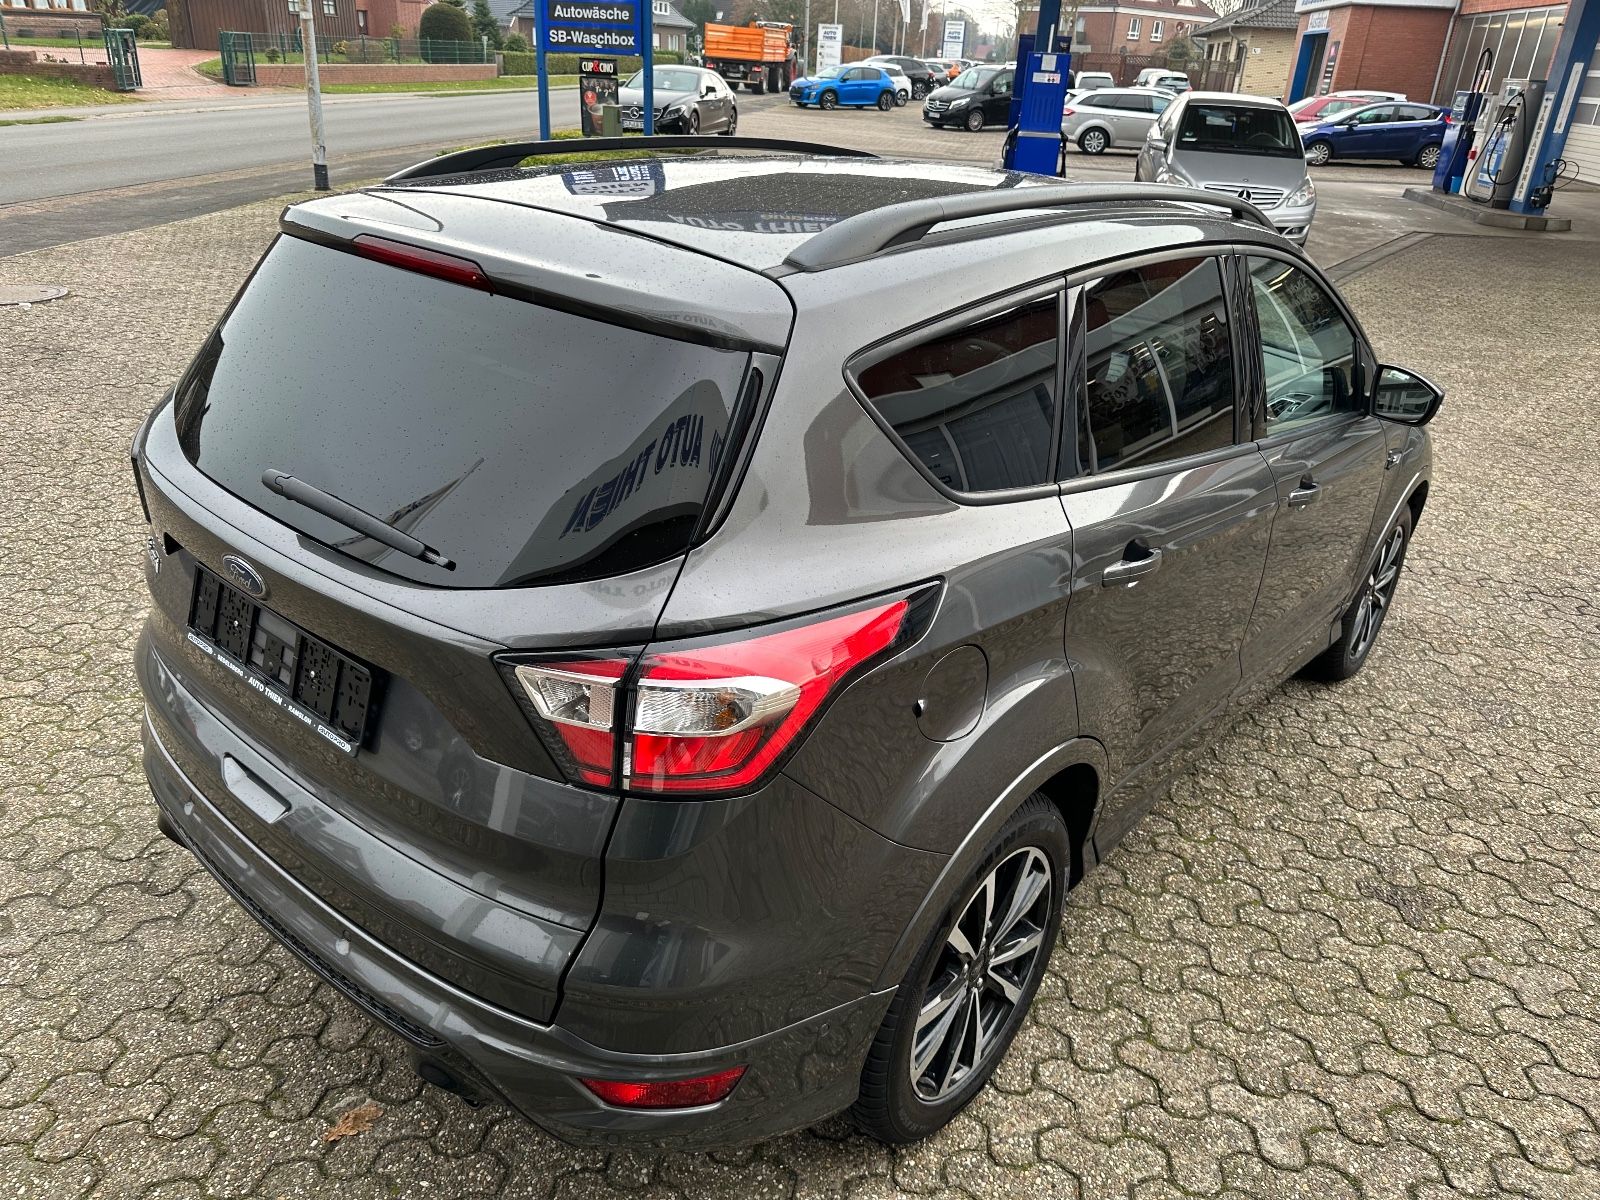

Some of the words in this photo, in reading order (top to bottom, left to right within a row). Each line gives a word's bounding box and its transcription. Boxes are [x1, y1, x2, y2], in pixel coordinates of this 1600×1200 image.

[554, 4, 630, 20] Autowäsche
[549, 29, 635, 46] SB-Waschbox
[581, 60, 614, 74] CUP&CINO
[229, 563, 252, 591] Ford
[248, 676, 265, 692] AUTO
[264, 687, 283, 705] THIEN
